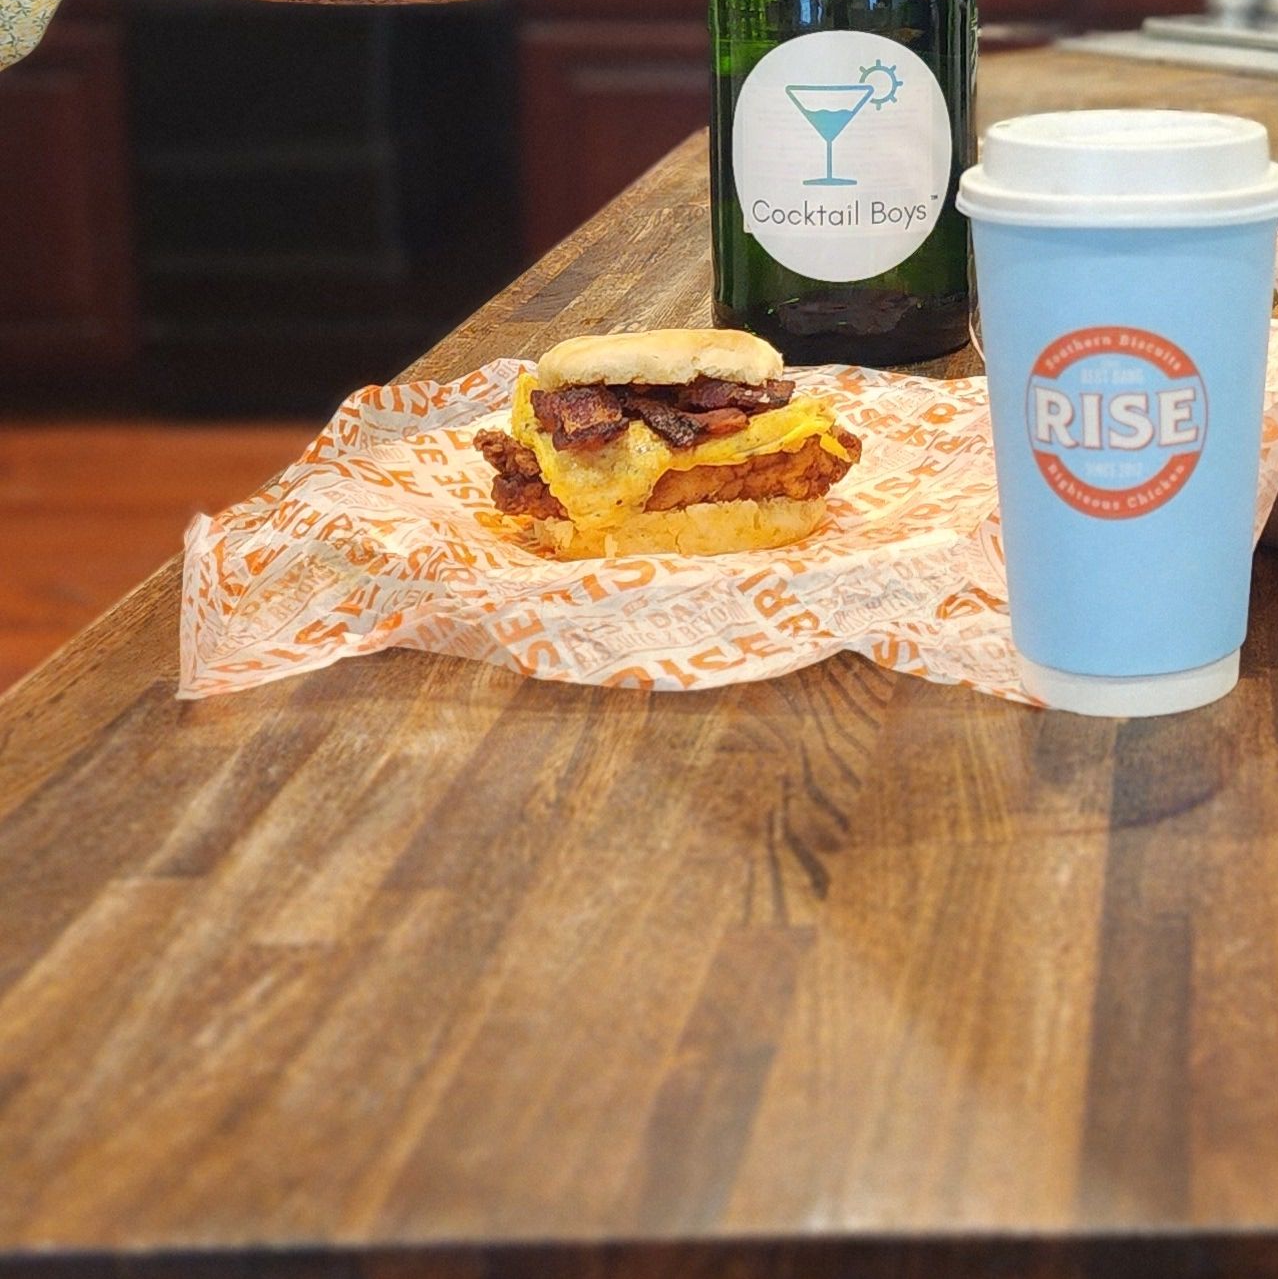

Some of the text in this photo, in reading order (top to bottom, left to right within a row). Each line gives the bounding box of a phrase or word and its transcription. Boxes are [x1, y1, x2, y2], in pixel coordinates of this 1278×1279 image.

[752, 199, 859, 226] Cocktail
[1045, 333, 1182, 372] Southern Biscuits
[1034, 384, 1200, 451] RISE
[1127, 463, 1185, 509] Chicken
